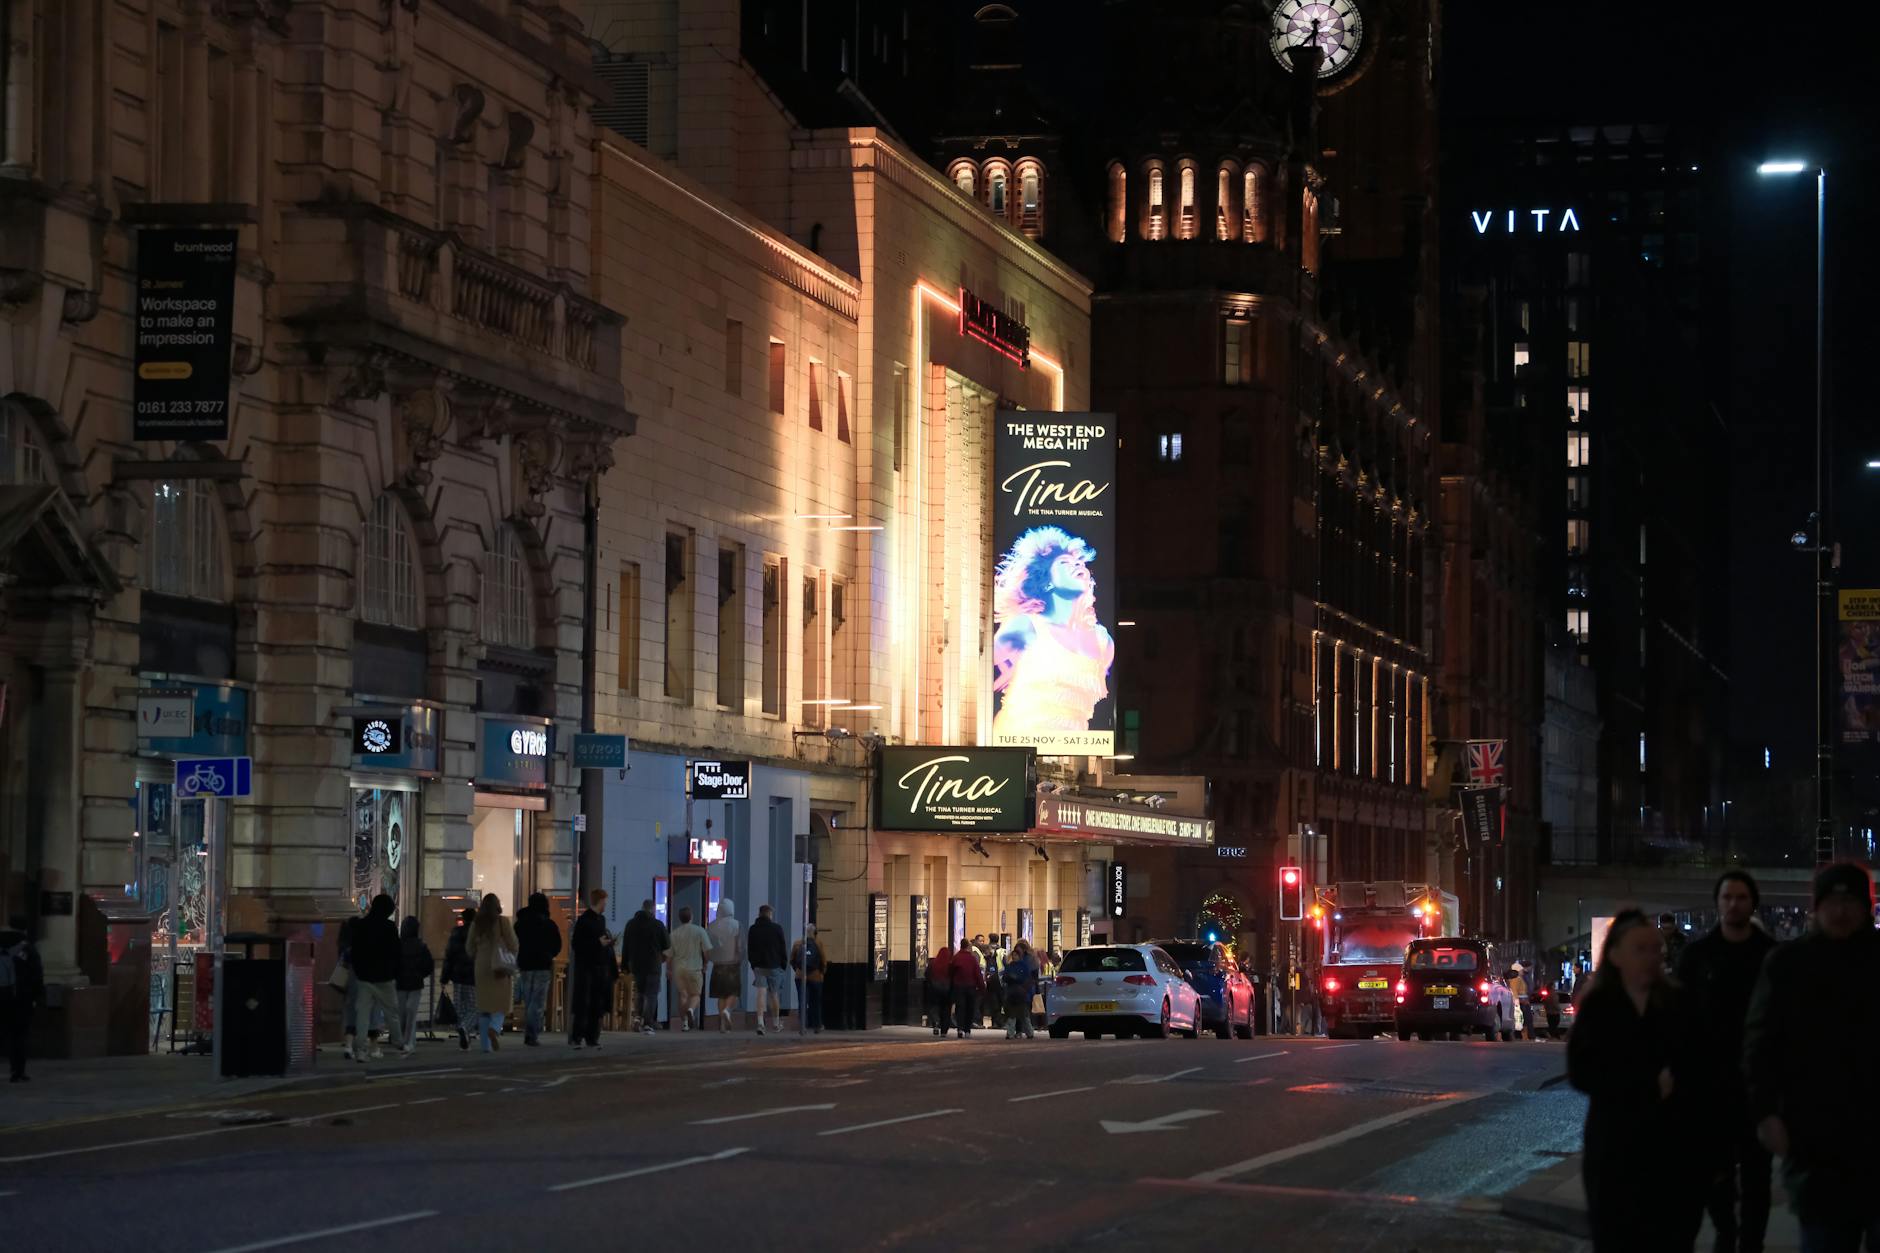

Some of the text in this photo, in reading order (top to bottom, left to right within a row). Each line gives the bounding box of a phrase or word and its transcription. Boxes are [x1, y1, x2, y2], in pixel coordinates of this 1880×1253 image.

[1472, 208, 1579, 233] VITA
[174, 241, 232, 252] bruntwood
[141, 297, 216, 313] Workspace
[140, 314, 215, 328] to make an
[140, 330, 214, 348] impression
[137, 401, 224, 414] 0161 233 7877
[1007, 424, 1105, 437] THE WEST END
[1023, 437, 1089, 450] MEGA HIT
[1002, 460, 1109, 516] Tina
[511, 729, 547, 757] GYROS
[1033, 736, 1055, 744] NOV
[1090, 737, 1110, 745] JAN
[698, 773, 743, 788] Stage Door
[898, 755, 1009, 813] Tina
[727, 787, 743, 795] BAR
[1086, 809, 1095, 827] ONE
[1115, 866, 1123, 903] BOX OFFICE
